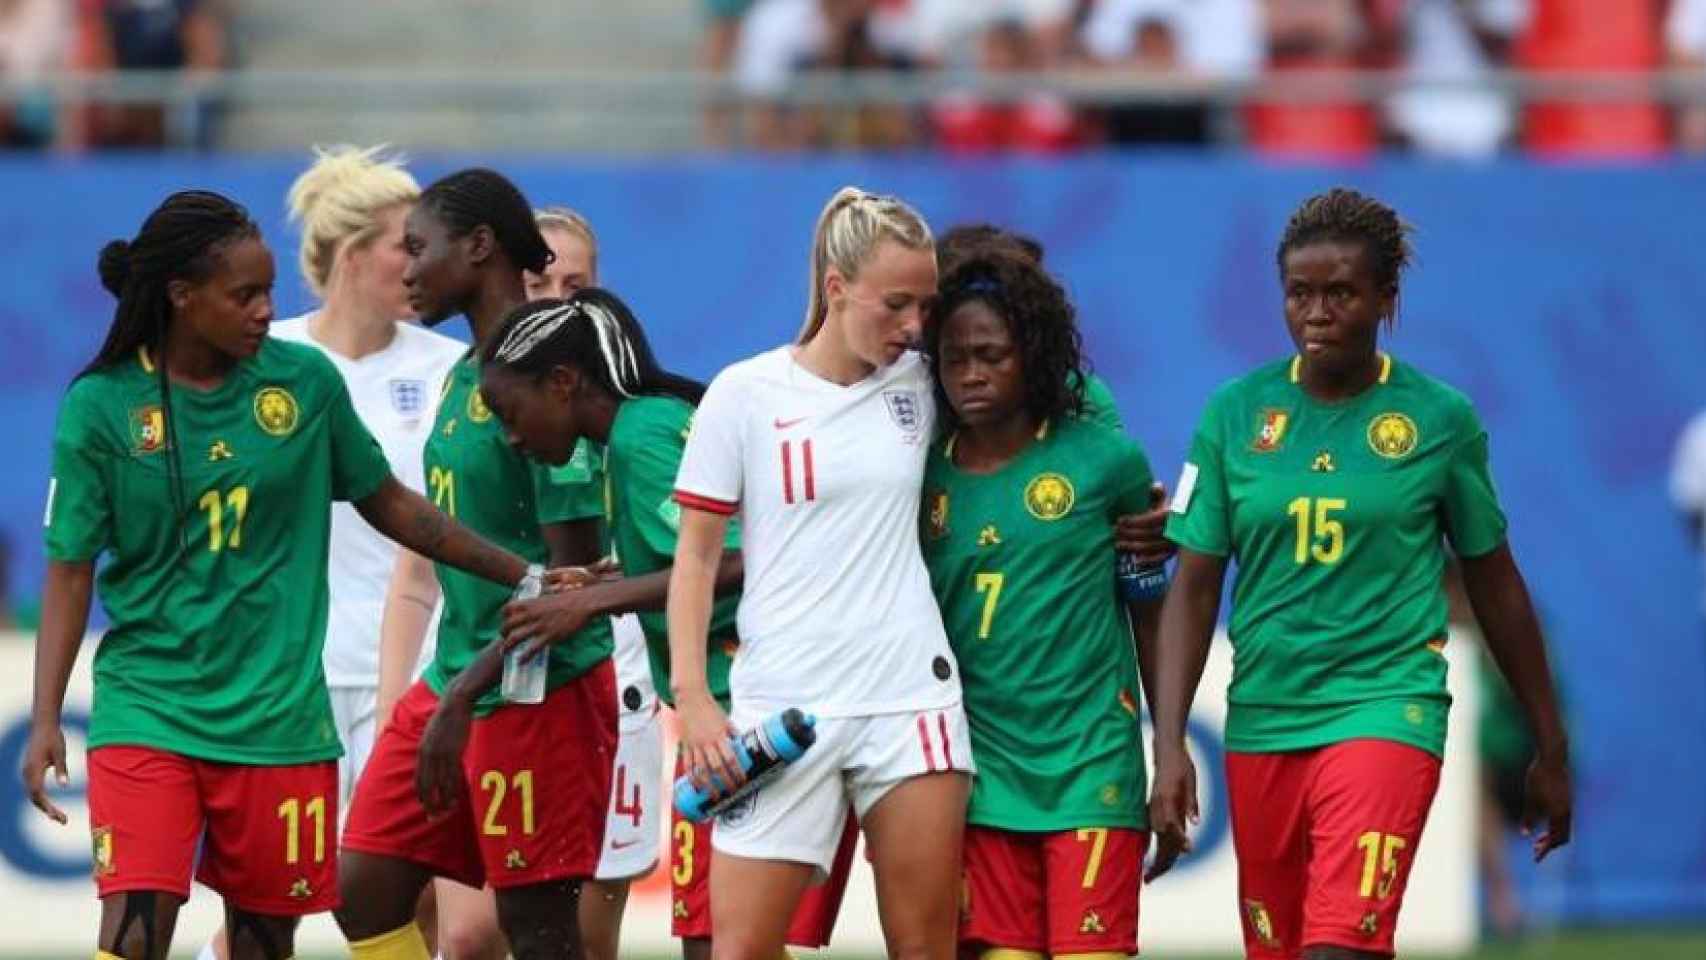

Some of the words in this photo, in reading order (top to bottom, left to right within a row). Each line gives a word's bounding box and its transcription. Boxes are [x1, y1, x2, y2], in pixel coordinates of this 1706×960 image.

[430, 466, 455, 517] 21
[781, 439, 816, 504] 11
[199, 485, 249, 552] 11
[1288, 497, 1347, 564] 15
[975, 573, 1005, 639] 7
[917, 712, 953, 770] 11
[481, 769, 536, 836] 21
[615, 765, 643, 828] 4
[277, 797, 325, 865] 11
[672, 819, 695, 886] 3
[1076, 828, 1108, 888] 7
[1358, 831, 1406, 900] 15
